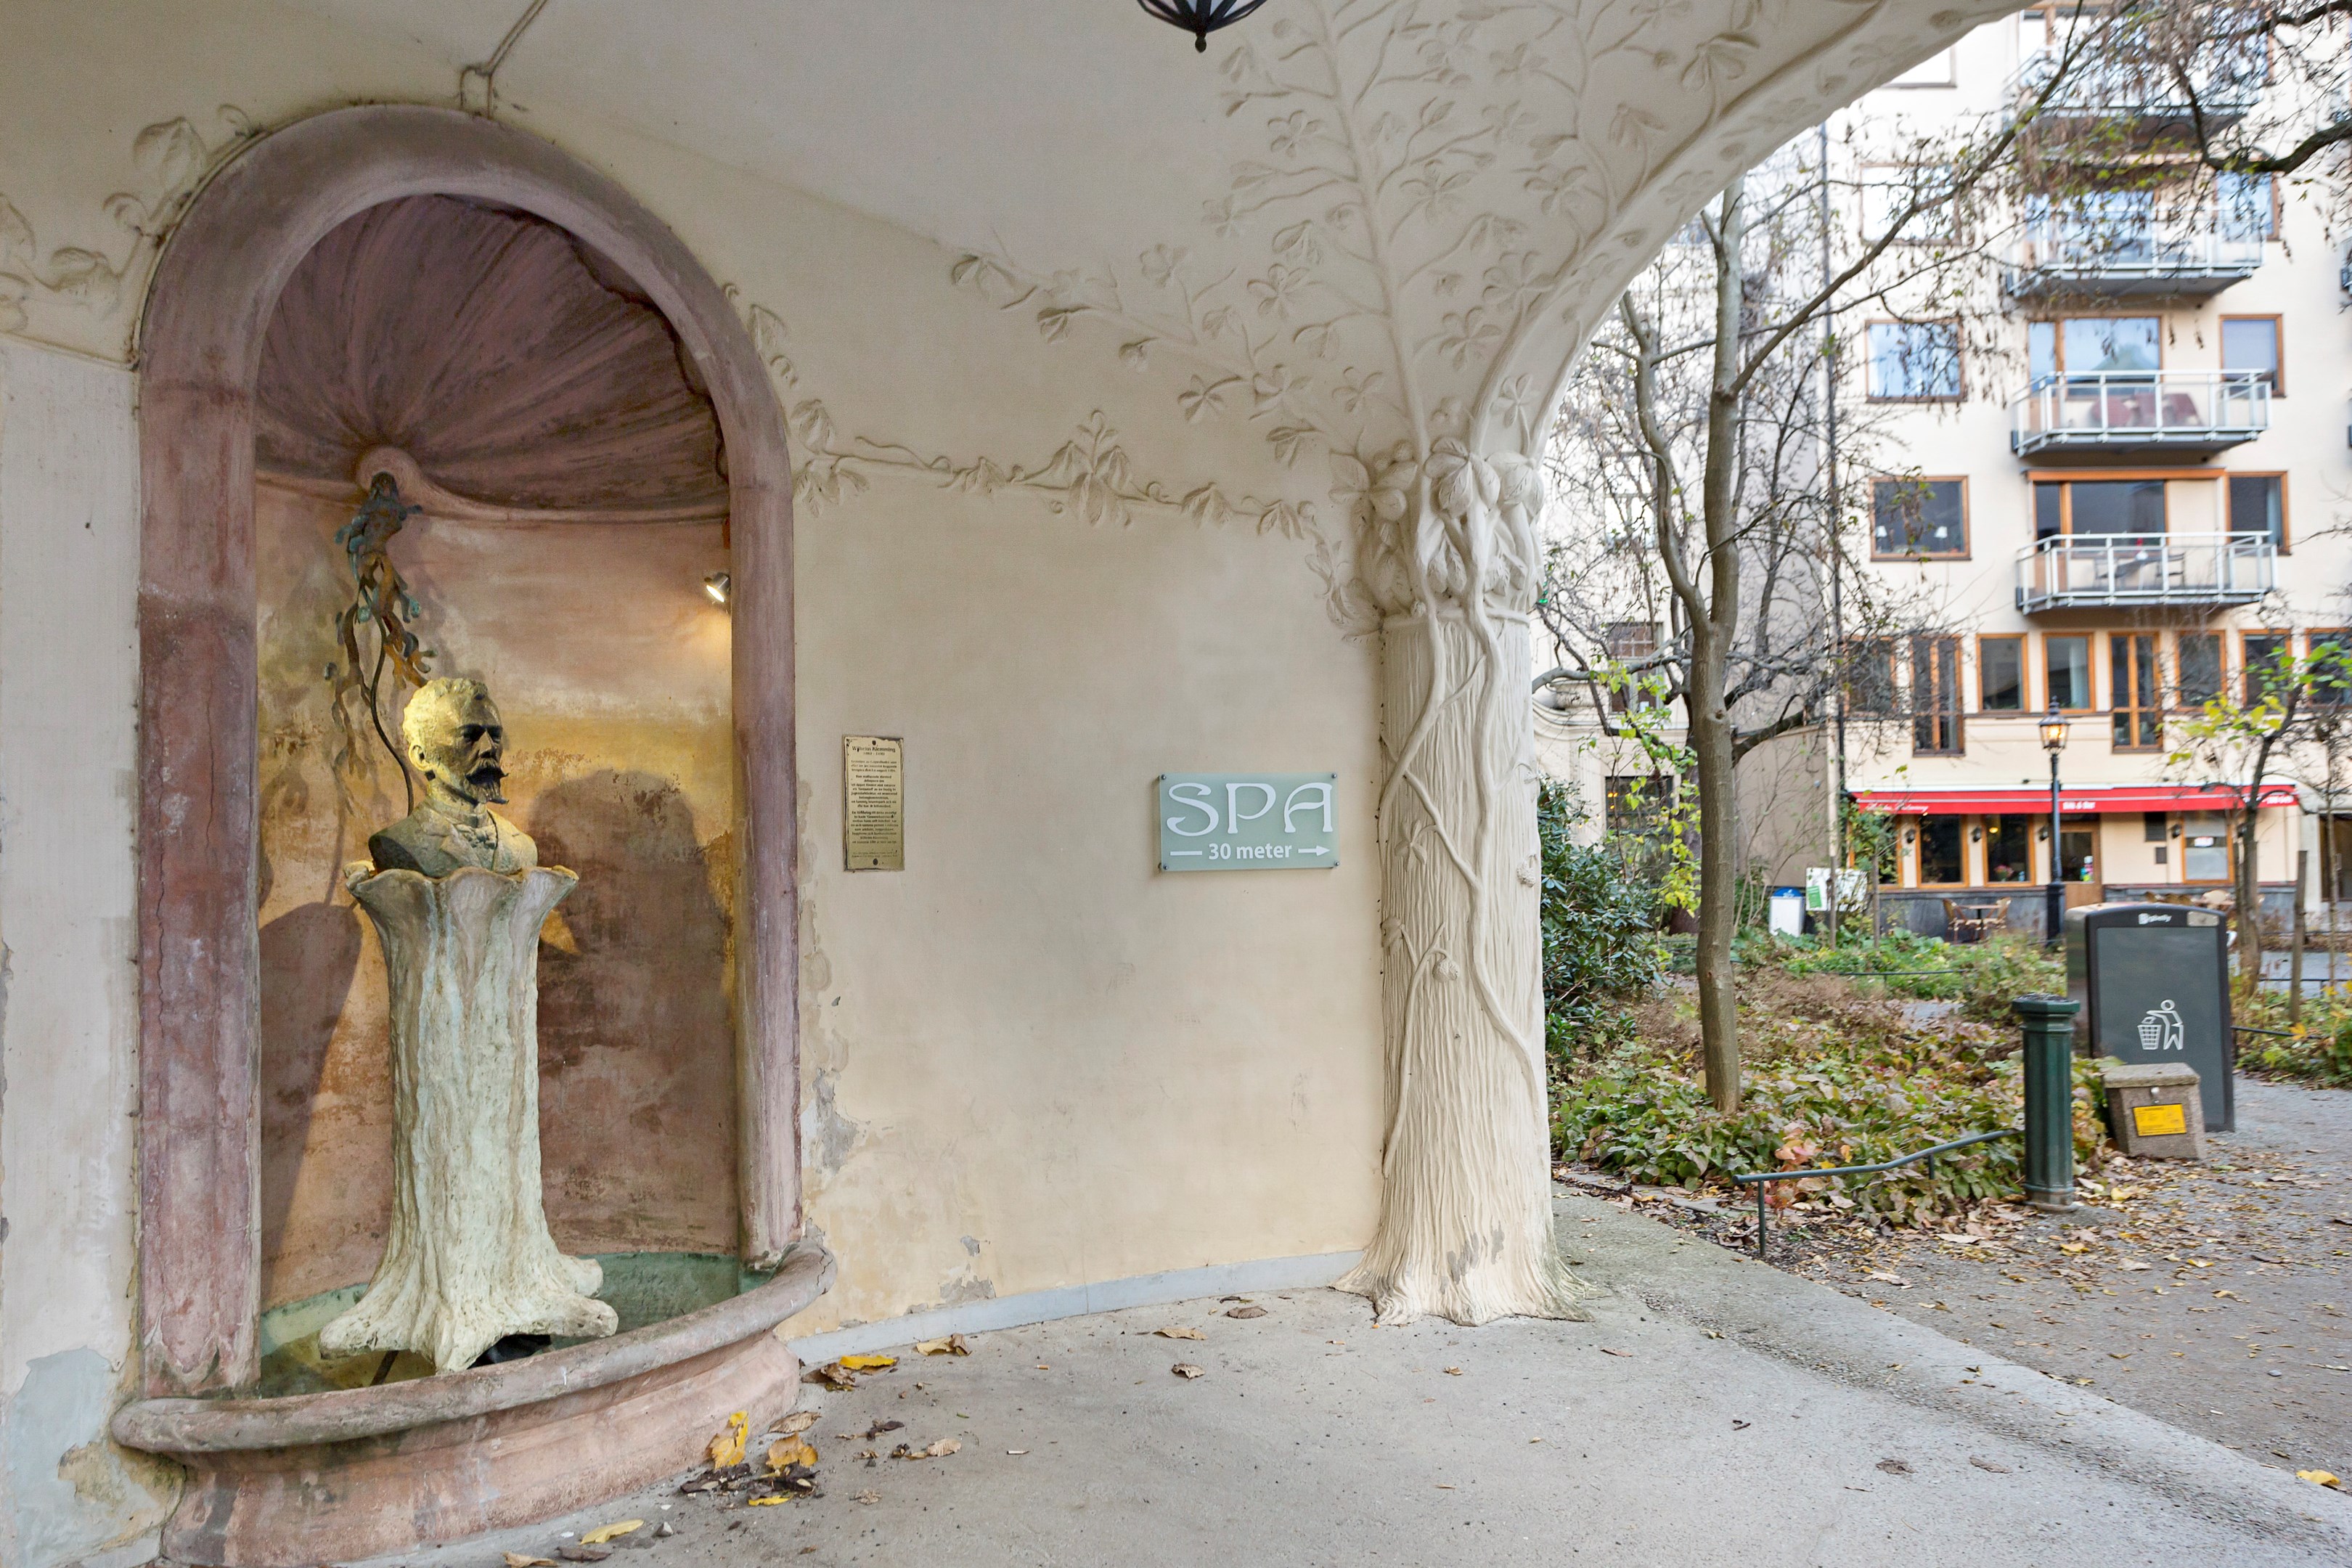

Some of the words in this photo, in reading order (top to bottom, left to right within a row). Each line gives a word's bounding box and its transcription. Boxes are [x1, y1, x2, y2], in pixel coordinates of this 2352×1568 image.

[1166, 782, 1334, 837] SPA
[1208, 843, 1231, 860] 30
[1236, 843, 1292, 859] meter
